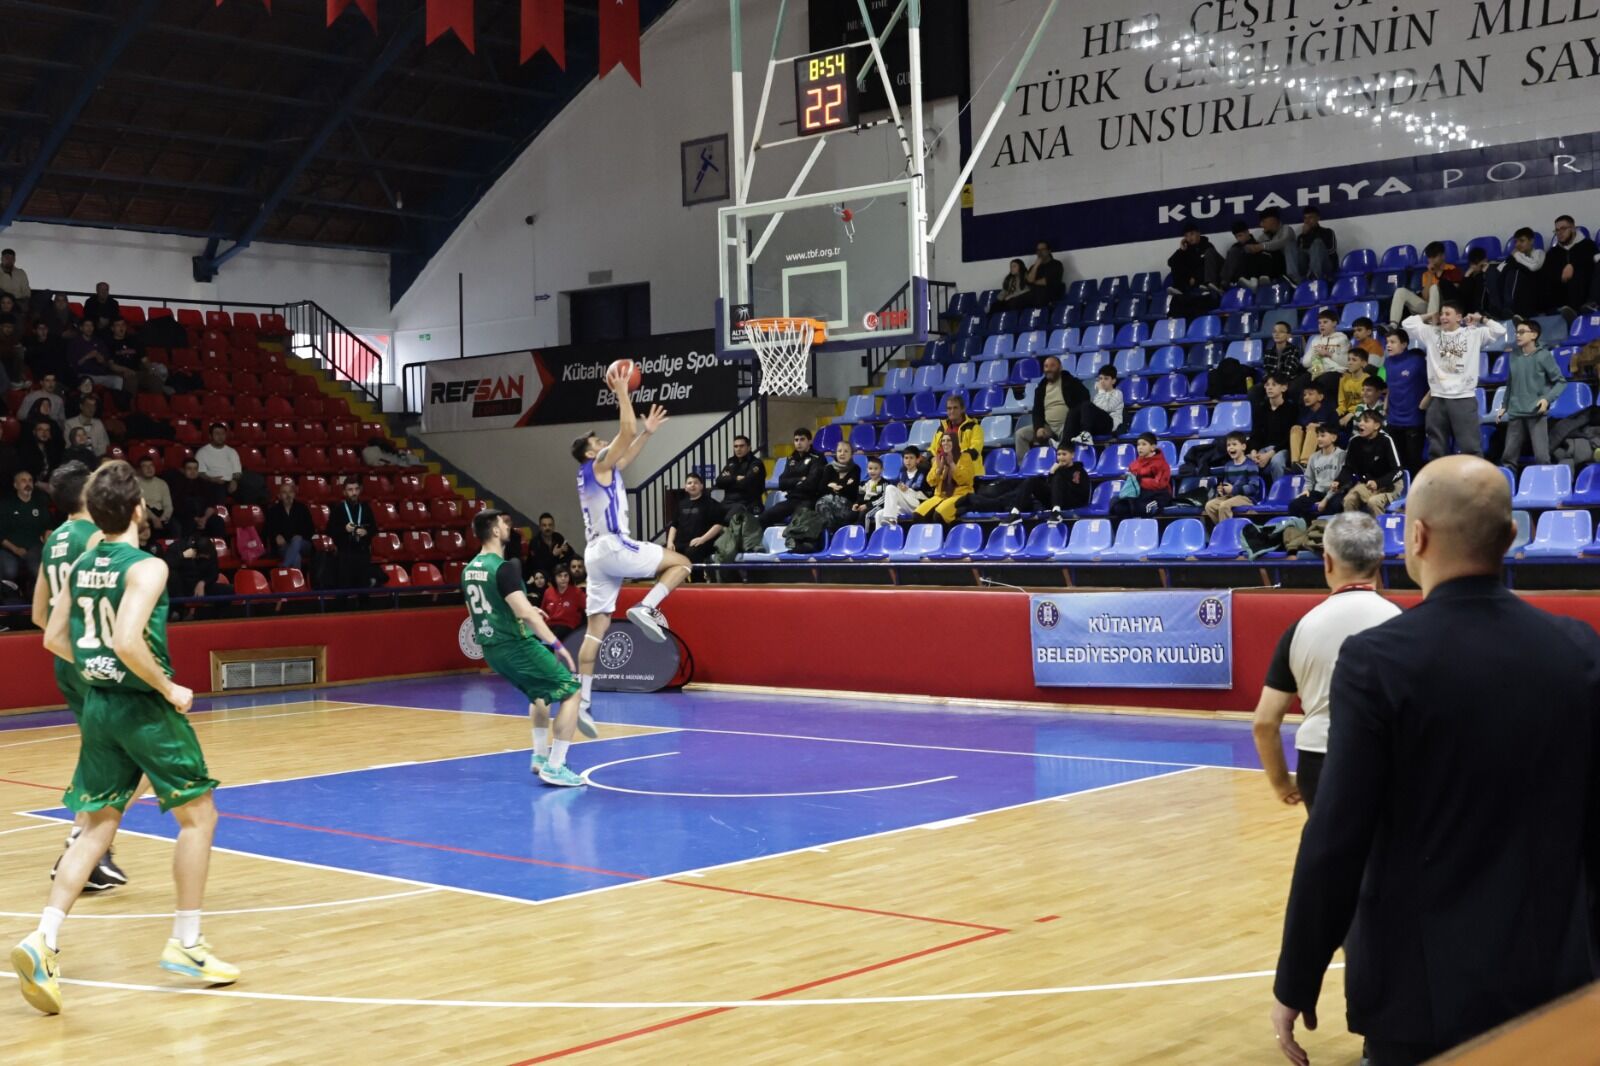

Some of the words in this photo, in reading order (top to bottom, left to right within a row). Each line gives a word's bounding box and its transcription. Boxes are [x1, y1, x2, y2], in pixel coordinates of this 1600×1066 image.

[809, 53, 846, 81] 8:54
[805, 84, 842, 129] 22
[1016, 67, 1121, 117] TÜRK
[991, 125, 1072, 168] ANA
[1158, 176, 1413, 225] KÜTAHYA
[785, 246, 841, 262] www.tbf.org.tr
[562, 361, 608, 383] Kütahy
[635, 354, 684, 378] elediye
[431, 375, 524, 405] REFSAN
[660, 382, 693, 401] Diler
[467, 584, 492, 614] 24
[1088, 613, 1164, 633] KÜTAHYA
[1037, 643, 1152, 663] BELEDİYESPOR
[1156, 643, 1224, 664] KULÜBÜ
